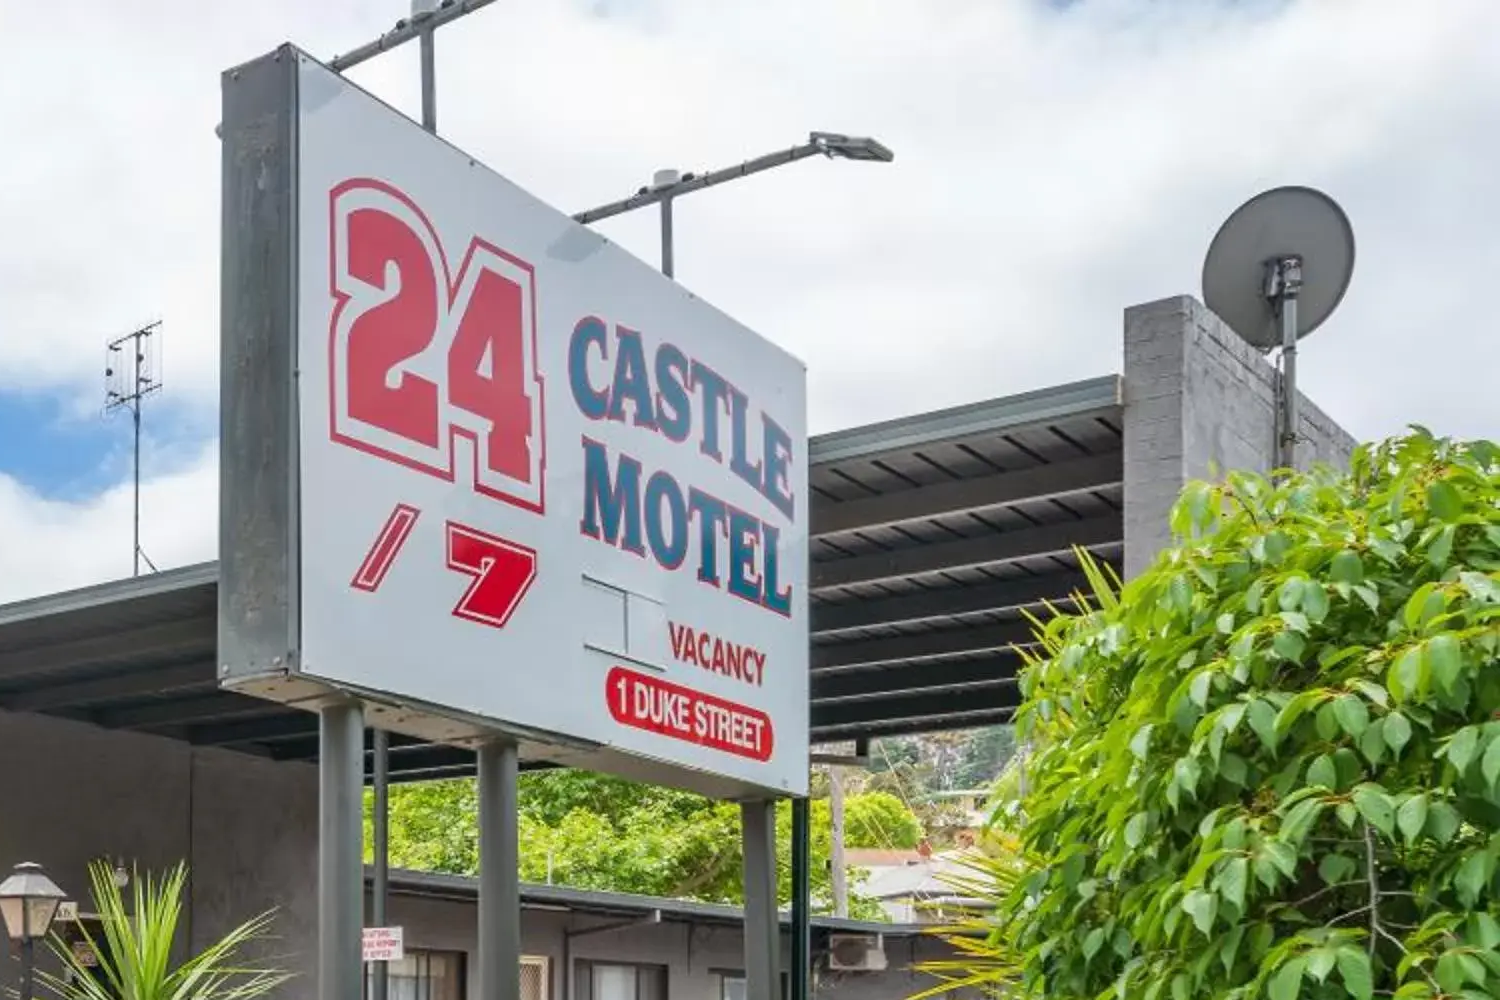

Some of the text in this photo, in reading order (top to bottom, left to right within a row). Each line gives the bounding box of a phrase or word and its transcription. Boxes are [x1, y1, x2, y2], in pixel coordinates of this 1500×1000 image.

[329, 177, 546, 515] 24
[568, 315, 794, 522] CASTLE
[580, 433, 792, 618] MOTEL
[616, 676, 764, 752] 1 DUKE STREET
[668, 620, 766, 687] VACANCY
